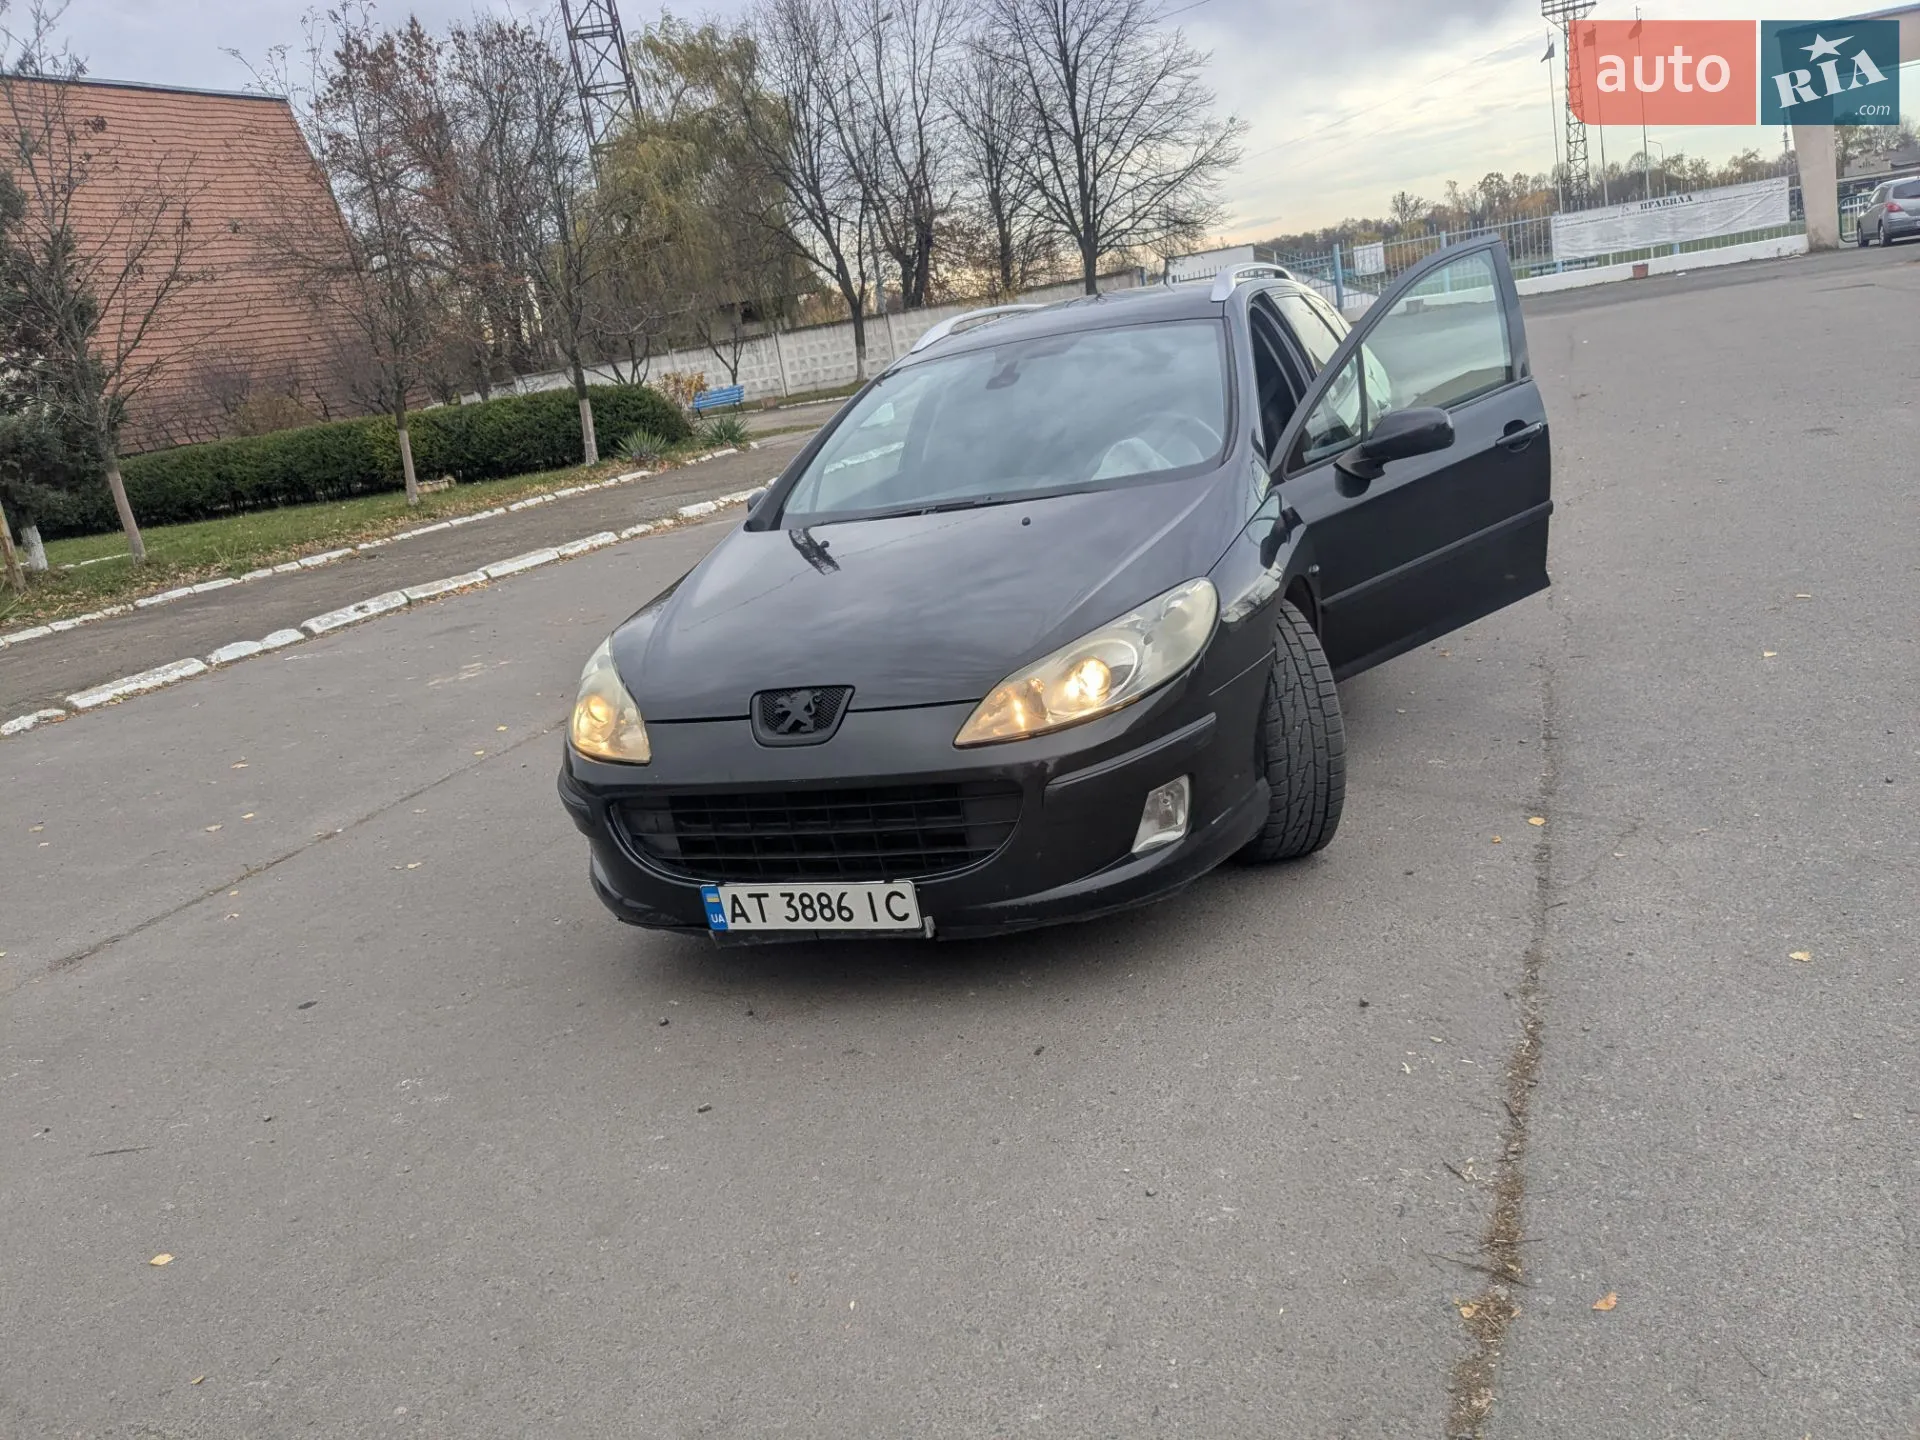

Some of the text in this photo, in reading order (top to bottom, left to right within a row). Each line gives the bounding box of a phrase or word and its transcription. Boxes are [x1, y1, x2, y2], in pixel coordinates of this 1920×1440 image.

[730, 890, 911, 924] AT 3886 IC
[711, 914, 725, 923] UA
